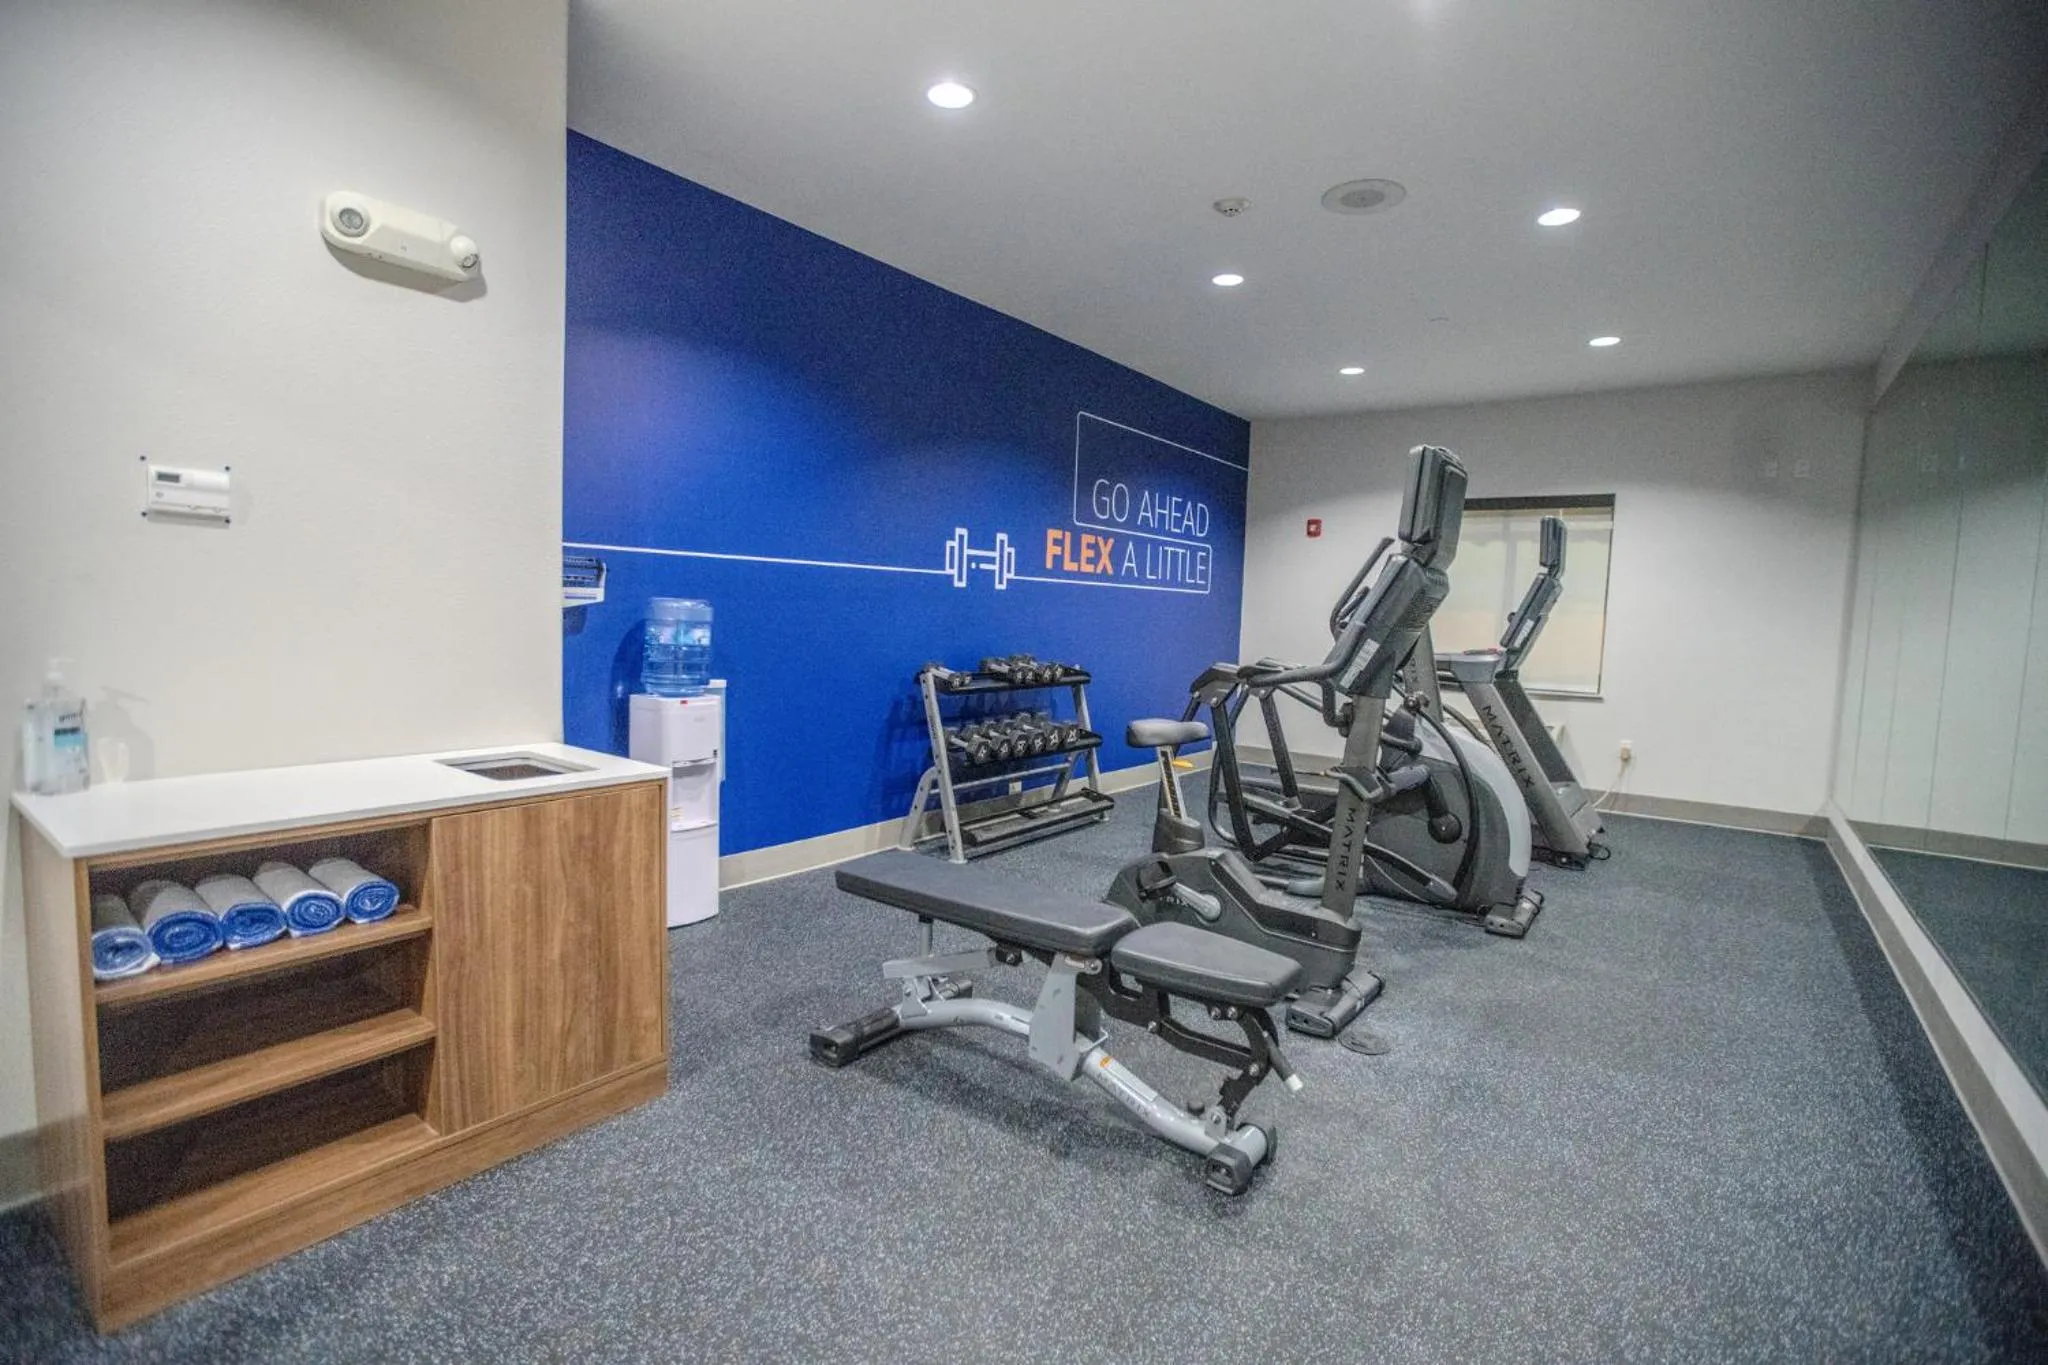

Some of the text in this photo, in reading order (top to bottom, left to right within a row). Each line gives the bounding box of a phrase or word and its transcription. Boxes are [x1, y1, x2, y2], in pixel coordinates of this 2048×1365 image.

[1093, 479, 1209, 537] GO AHEAD
[1045, 528, 1207, 585] FLEX A LITTLE
[1483, 705, 1535, 788] MATRIX
[1335, 807, 1356, 891] MATRIX
